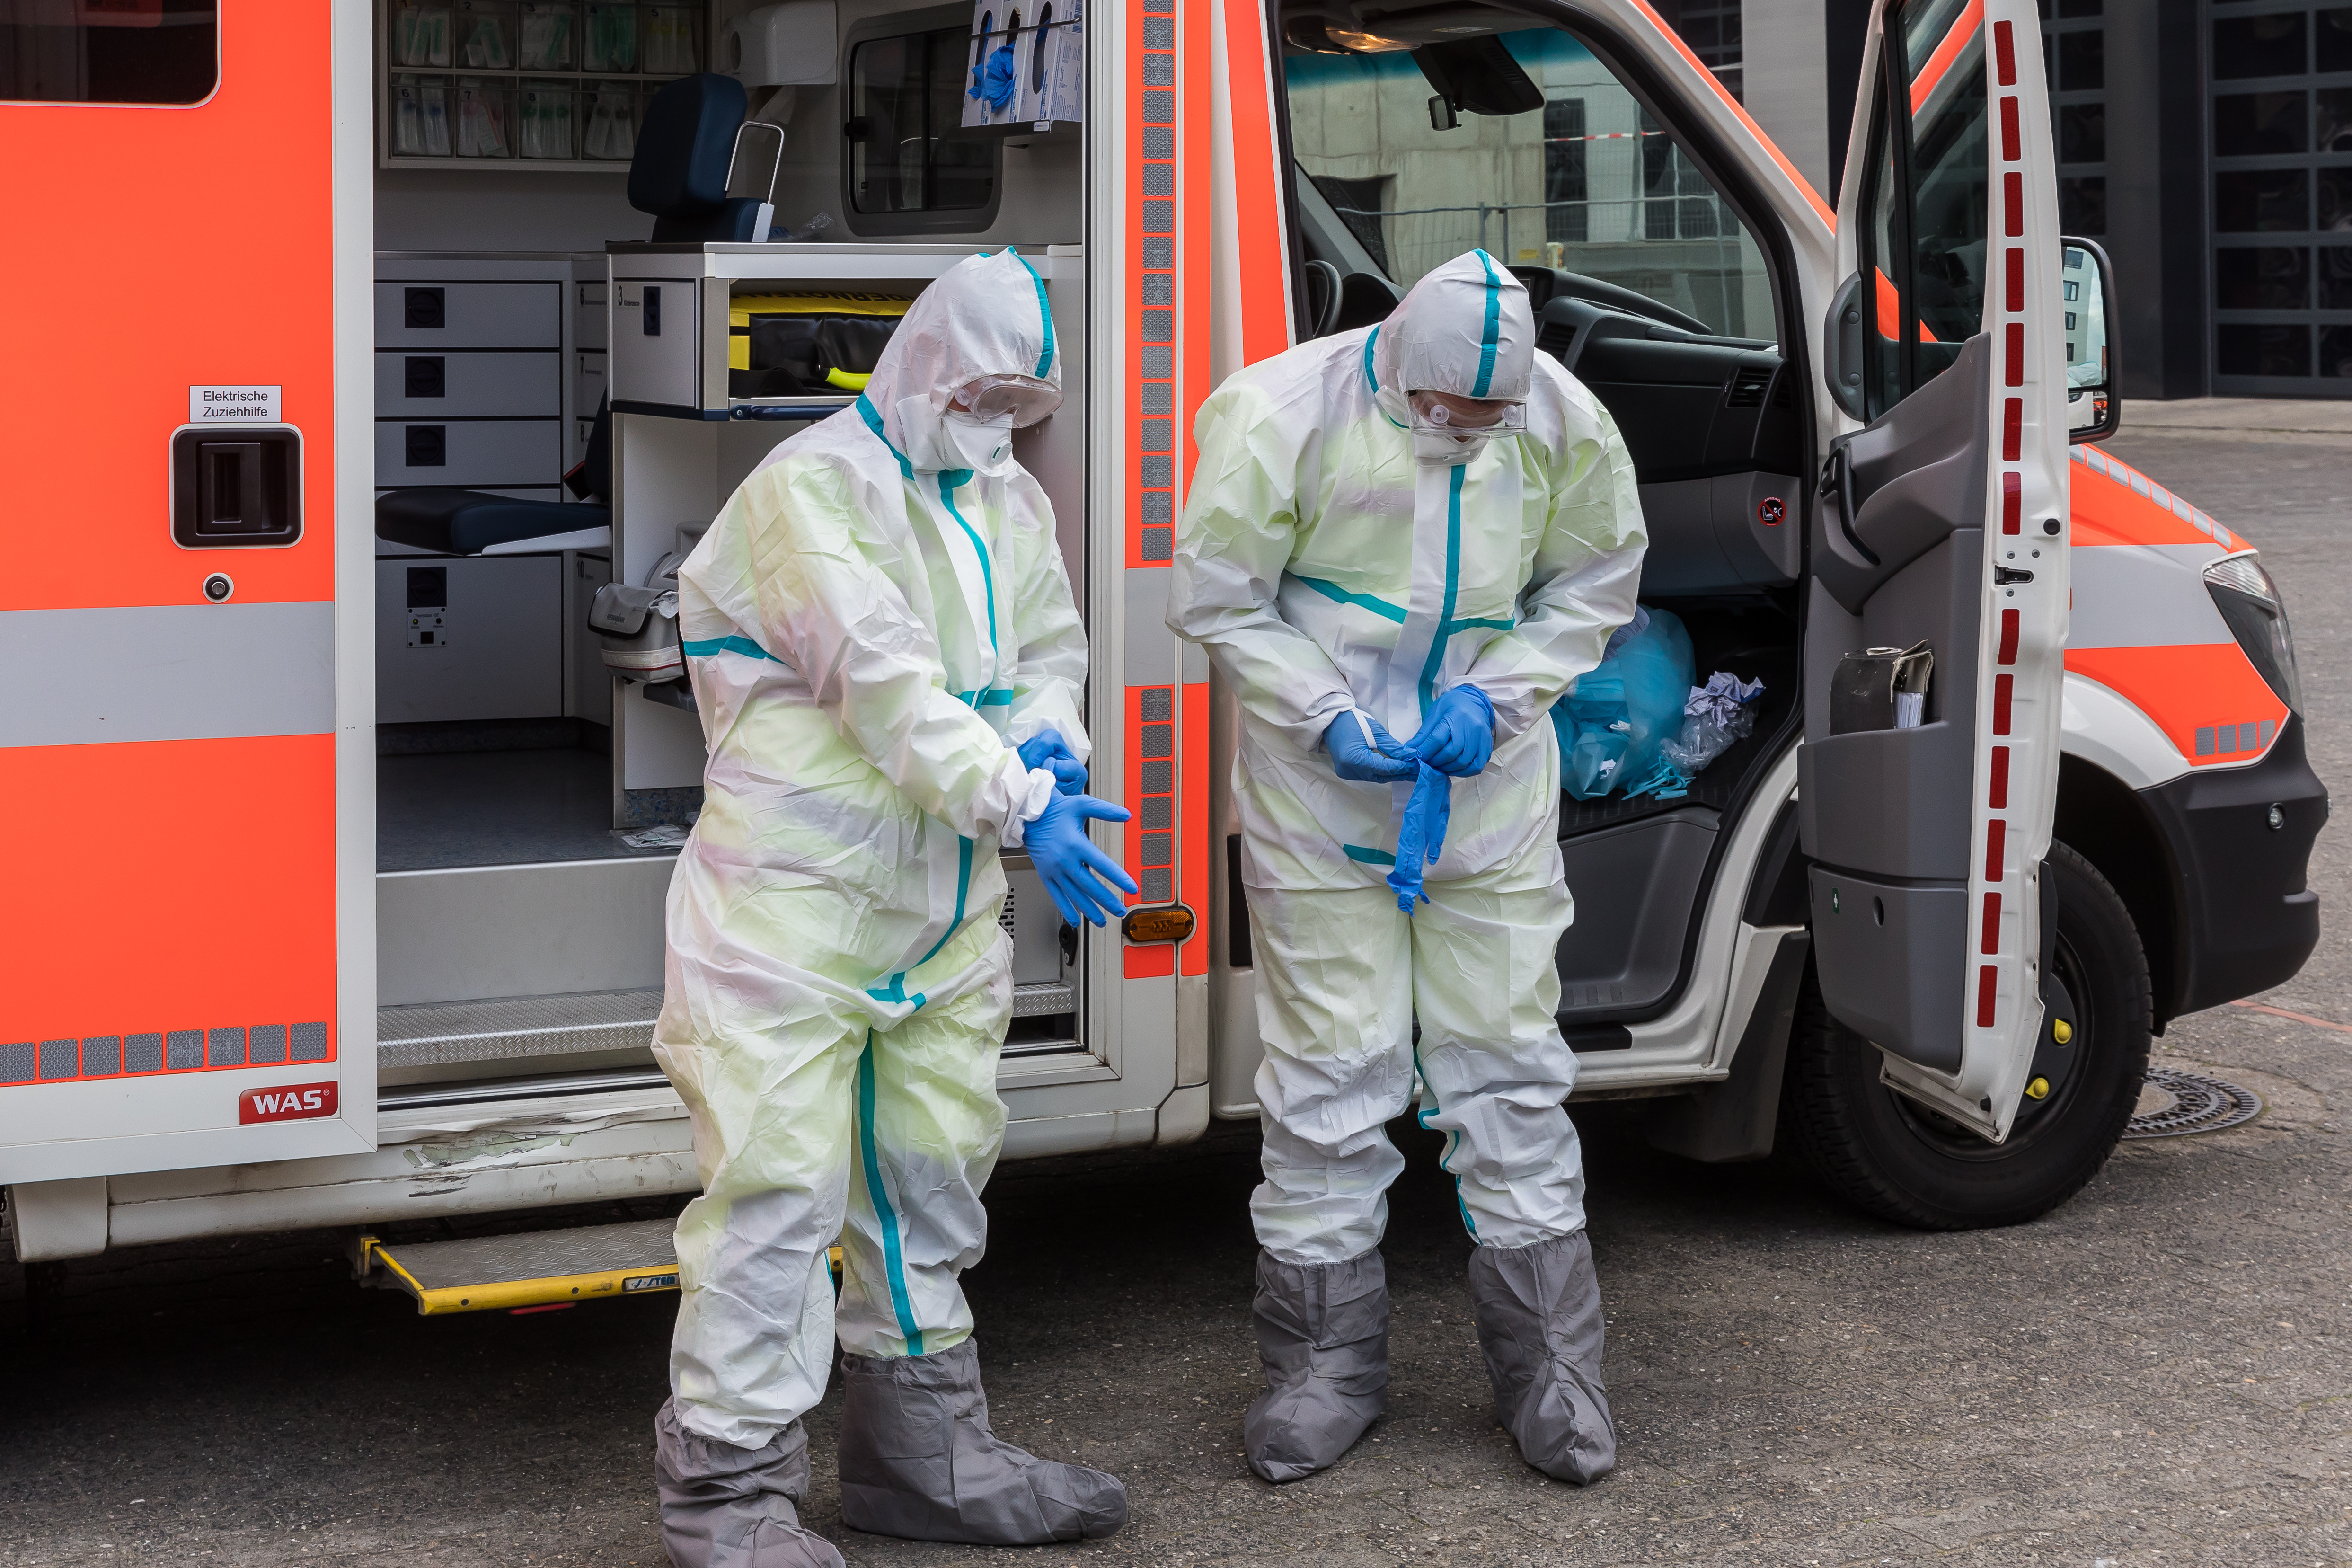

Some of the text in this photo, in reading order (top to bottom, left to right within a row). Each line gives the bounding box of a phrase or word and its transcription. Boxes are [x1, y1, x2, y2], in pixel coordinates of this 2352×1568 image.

[464, 2, 472, 10] 2
[527, 3, 536, 13] 3
[590, 6, 598, 15] 4
[651, 9, 659, 17] 5
[401, 89, 410, 98] 6
[463, 91, 471, 100] 7
[528, 92, 536, 102] 8
[580, 288, 584, 305] 6
[617, 285, 623, 306] 3
[580, 356, 584, 374] 7
[203, 391, 268, 401] Elektrische
[203, 406, 268, 417] Zuziehhilfe
[580, 424, 585, 442] 8
[576, 560, 584, 578] 10
